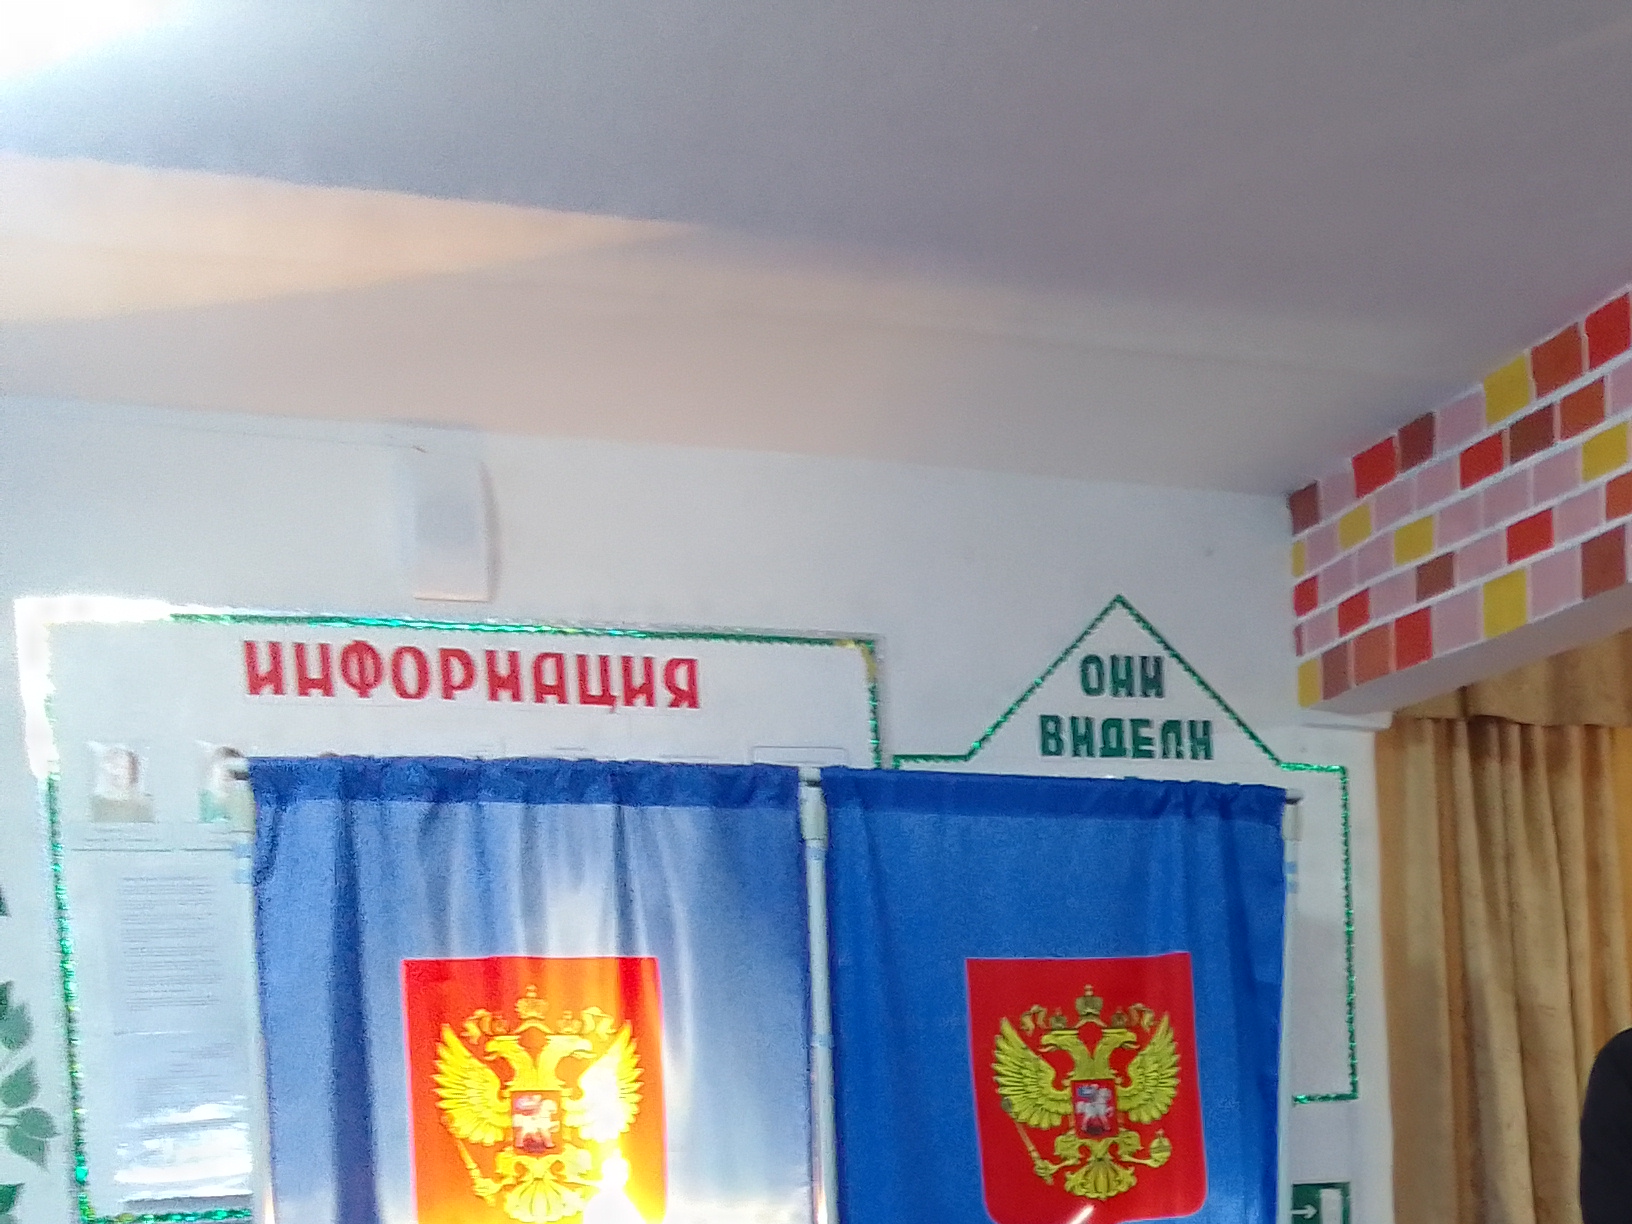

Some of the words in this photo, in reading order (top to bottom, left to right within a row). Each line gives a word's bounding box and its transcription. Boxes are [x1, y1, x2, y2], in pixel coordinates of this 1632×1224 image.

[242, 638, 701, 714] ИНФОРМАЦИЯ
[1080, 653, 1165, 698] ОНИ
[1039, 714, 1214, 760] ВИДЕЛИ
